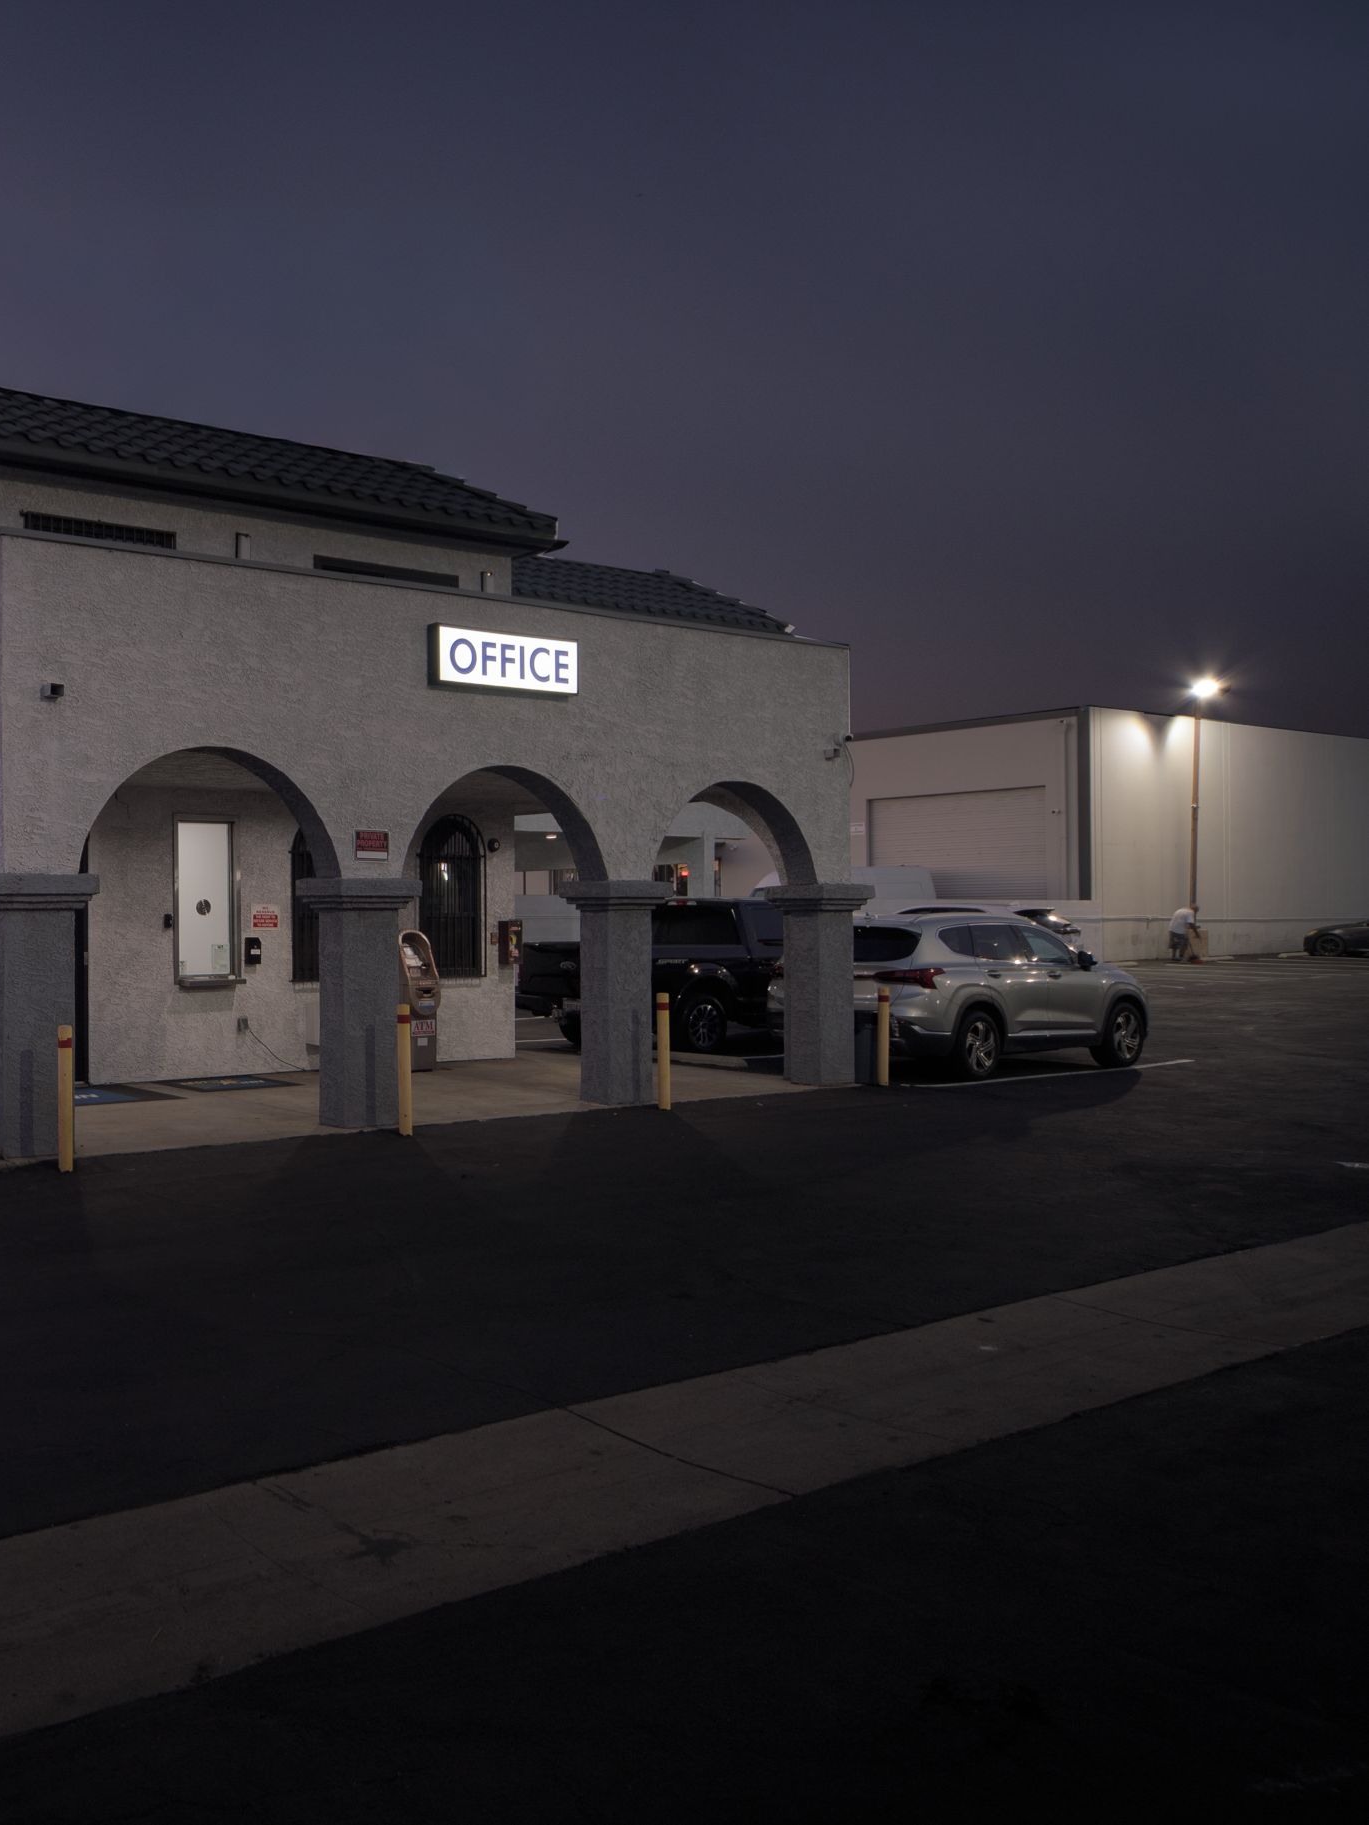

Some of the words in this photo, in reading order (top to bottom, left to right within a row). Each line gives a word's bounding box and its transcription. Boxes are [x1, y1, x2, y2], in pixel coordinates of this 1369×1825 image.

[449, 637, 570, 685] OFFICE
[359, 832, 384, 840] PRIVATE
[414, 1021, 433, 1031] ATM
